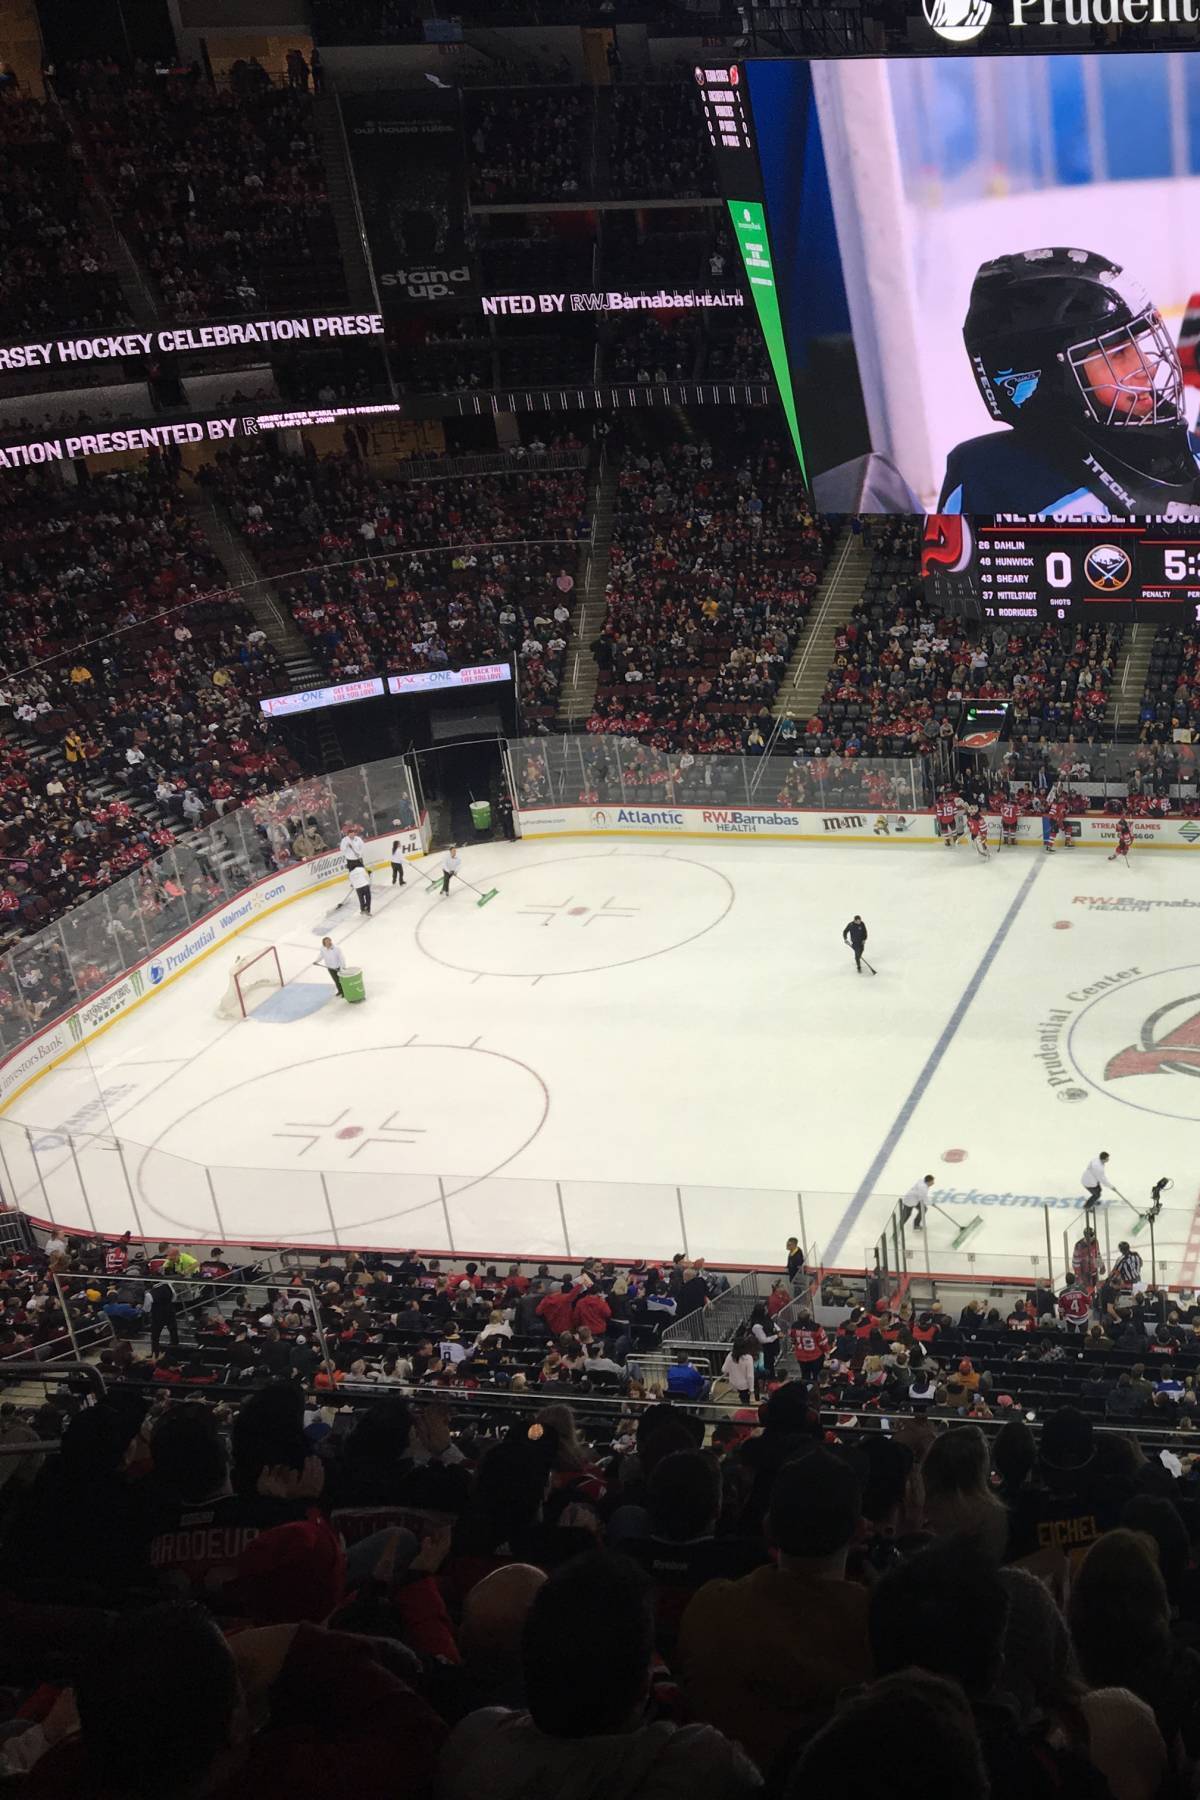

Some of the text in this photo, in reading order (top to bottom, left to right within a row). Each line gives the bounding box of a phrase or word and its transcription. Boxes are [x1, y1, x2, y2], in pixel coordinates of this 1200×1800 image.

[380, 265, 472, 287] stand
[407, 283, 456, 301] up.
[481, 295, 536, 315] NTED
[539, 293, 565, 313] BY
[695, 289, 744, 307] HEALTH
[58, 333, 154, 364] HOCKEY
[158, 319, 311, 352] CELEBRATION
[66, 421, 205, 458] PRESENTED
[208, 418, 237, 441] BY
[978, 541, 1025, 550] 26 DAHLIN
[995, 558, 1035, 567] HUNWICK
[1046, 552, 1072, 588] 0
[981, 575, 1029, 583] 43 SHEARY
[982, 591, 994, 600] 37
[1142, 591, 1171, 599] PENALTY
[985, 608, 1038, 617] 71 RODRIGUES
[617, 808, 684, 825] Atlantic
[702, 811, 800, 827] RWJBarnabas
[1003, 806, 1013, 818] 21
[716, 822, 757, 833] HEALTH
[1134, 823, 1161, 831] GAMES
[1100, 832, 1115, 840] LIVE
[219, 902, 253, 930] Walmart
[1087, 904, 1150, 913] HEALTH
[165, 926, 217, 973] Prudential
[1033, 966, 1143, 1090] Prudential Center
[1070, 1299, 1079, 1313] 4
[1036, 1513, 1103, 1549] EICHEL
